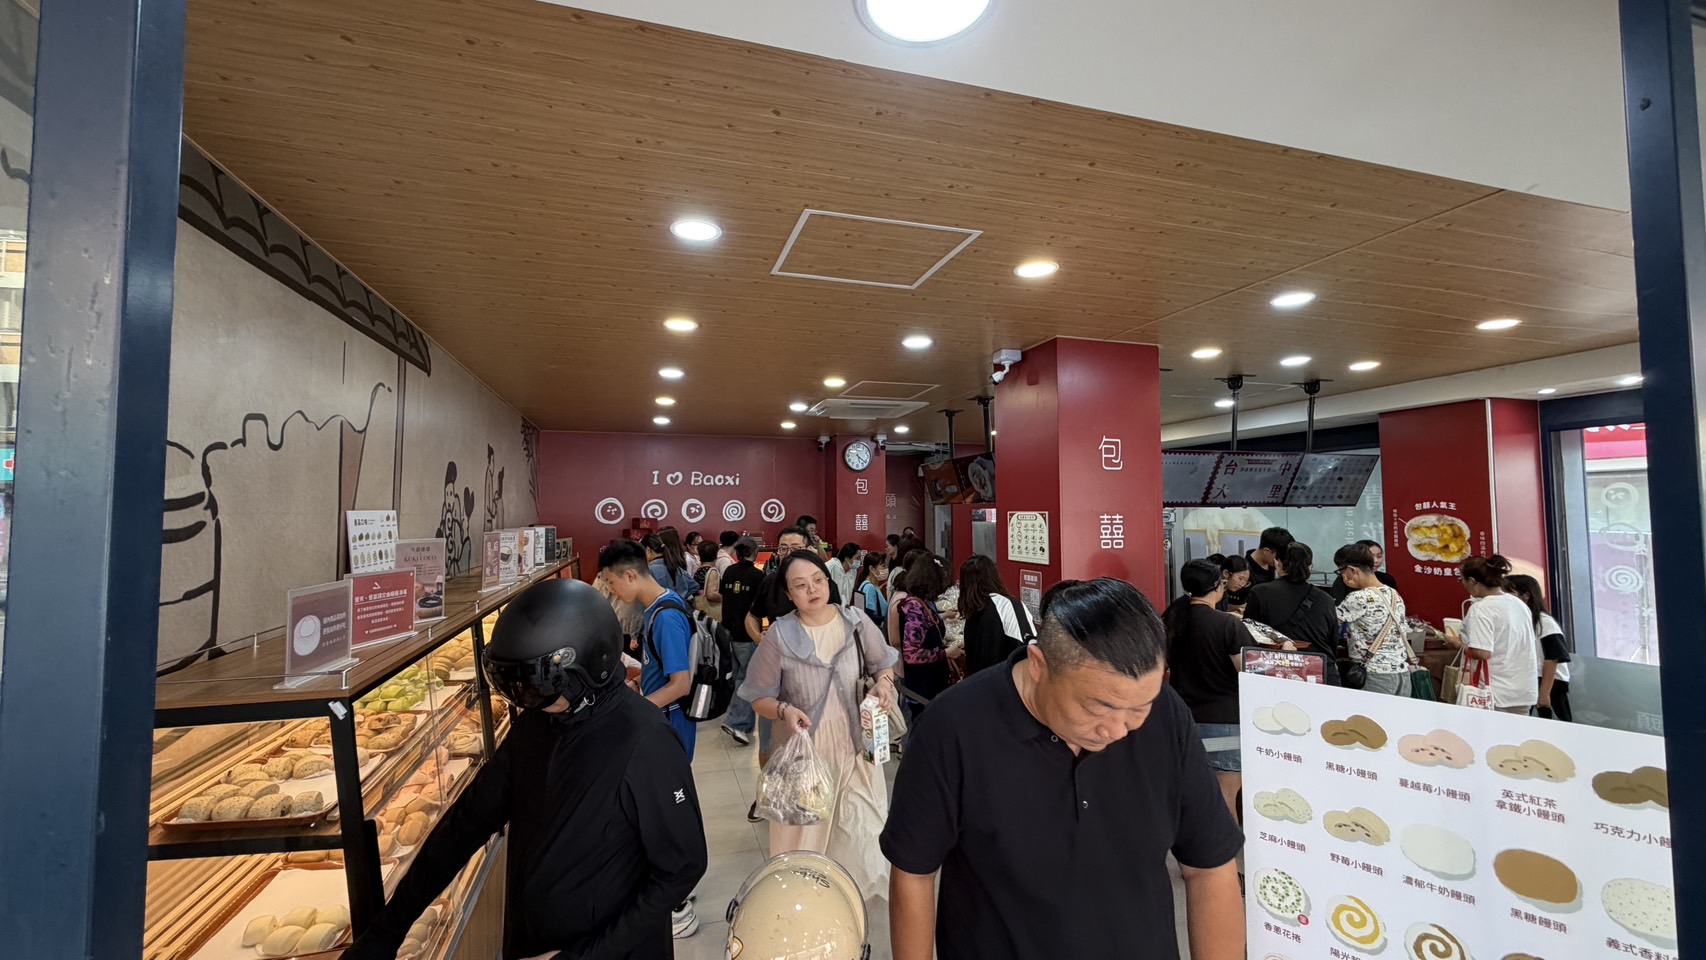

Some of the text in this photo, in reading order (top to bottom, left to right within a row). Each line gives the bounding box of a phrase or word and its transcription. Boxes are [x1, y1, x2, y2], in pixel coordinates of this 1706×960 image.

[652, 470, 740, 486] I Baoxi
[1223, 460, 1292, 476] 台 中
[1098, 435, 1124, 549] 包囍
[1267, 485, 1283, 499] 里
[1256, 746, 1303, 764] 牛奶小饅頭
[1325, 761, 1378, 781] 黑糖小饅頭
[1398, 778, 1472, 803] 蔓越莓小饅頭
[1501, 788, 1557, 810] 英式紅茶
[1495, 800, 1566, 824] 拿鐵小饅頭
[1259, 831, 1306, 853] 芝麻小饅頭
[1330, 852, 1384, 877] 野莓小饅頭
[1402, 874, 1476, 906] 濃郁牛奶饅頭
[1510, 907, 1567, 934] 黑糖饅頭
[1606, 937, 1679, 960] 義式香料
